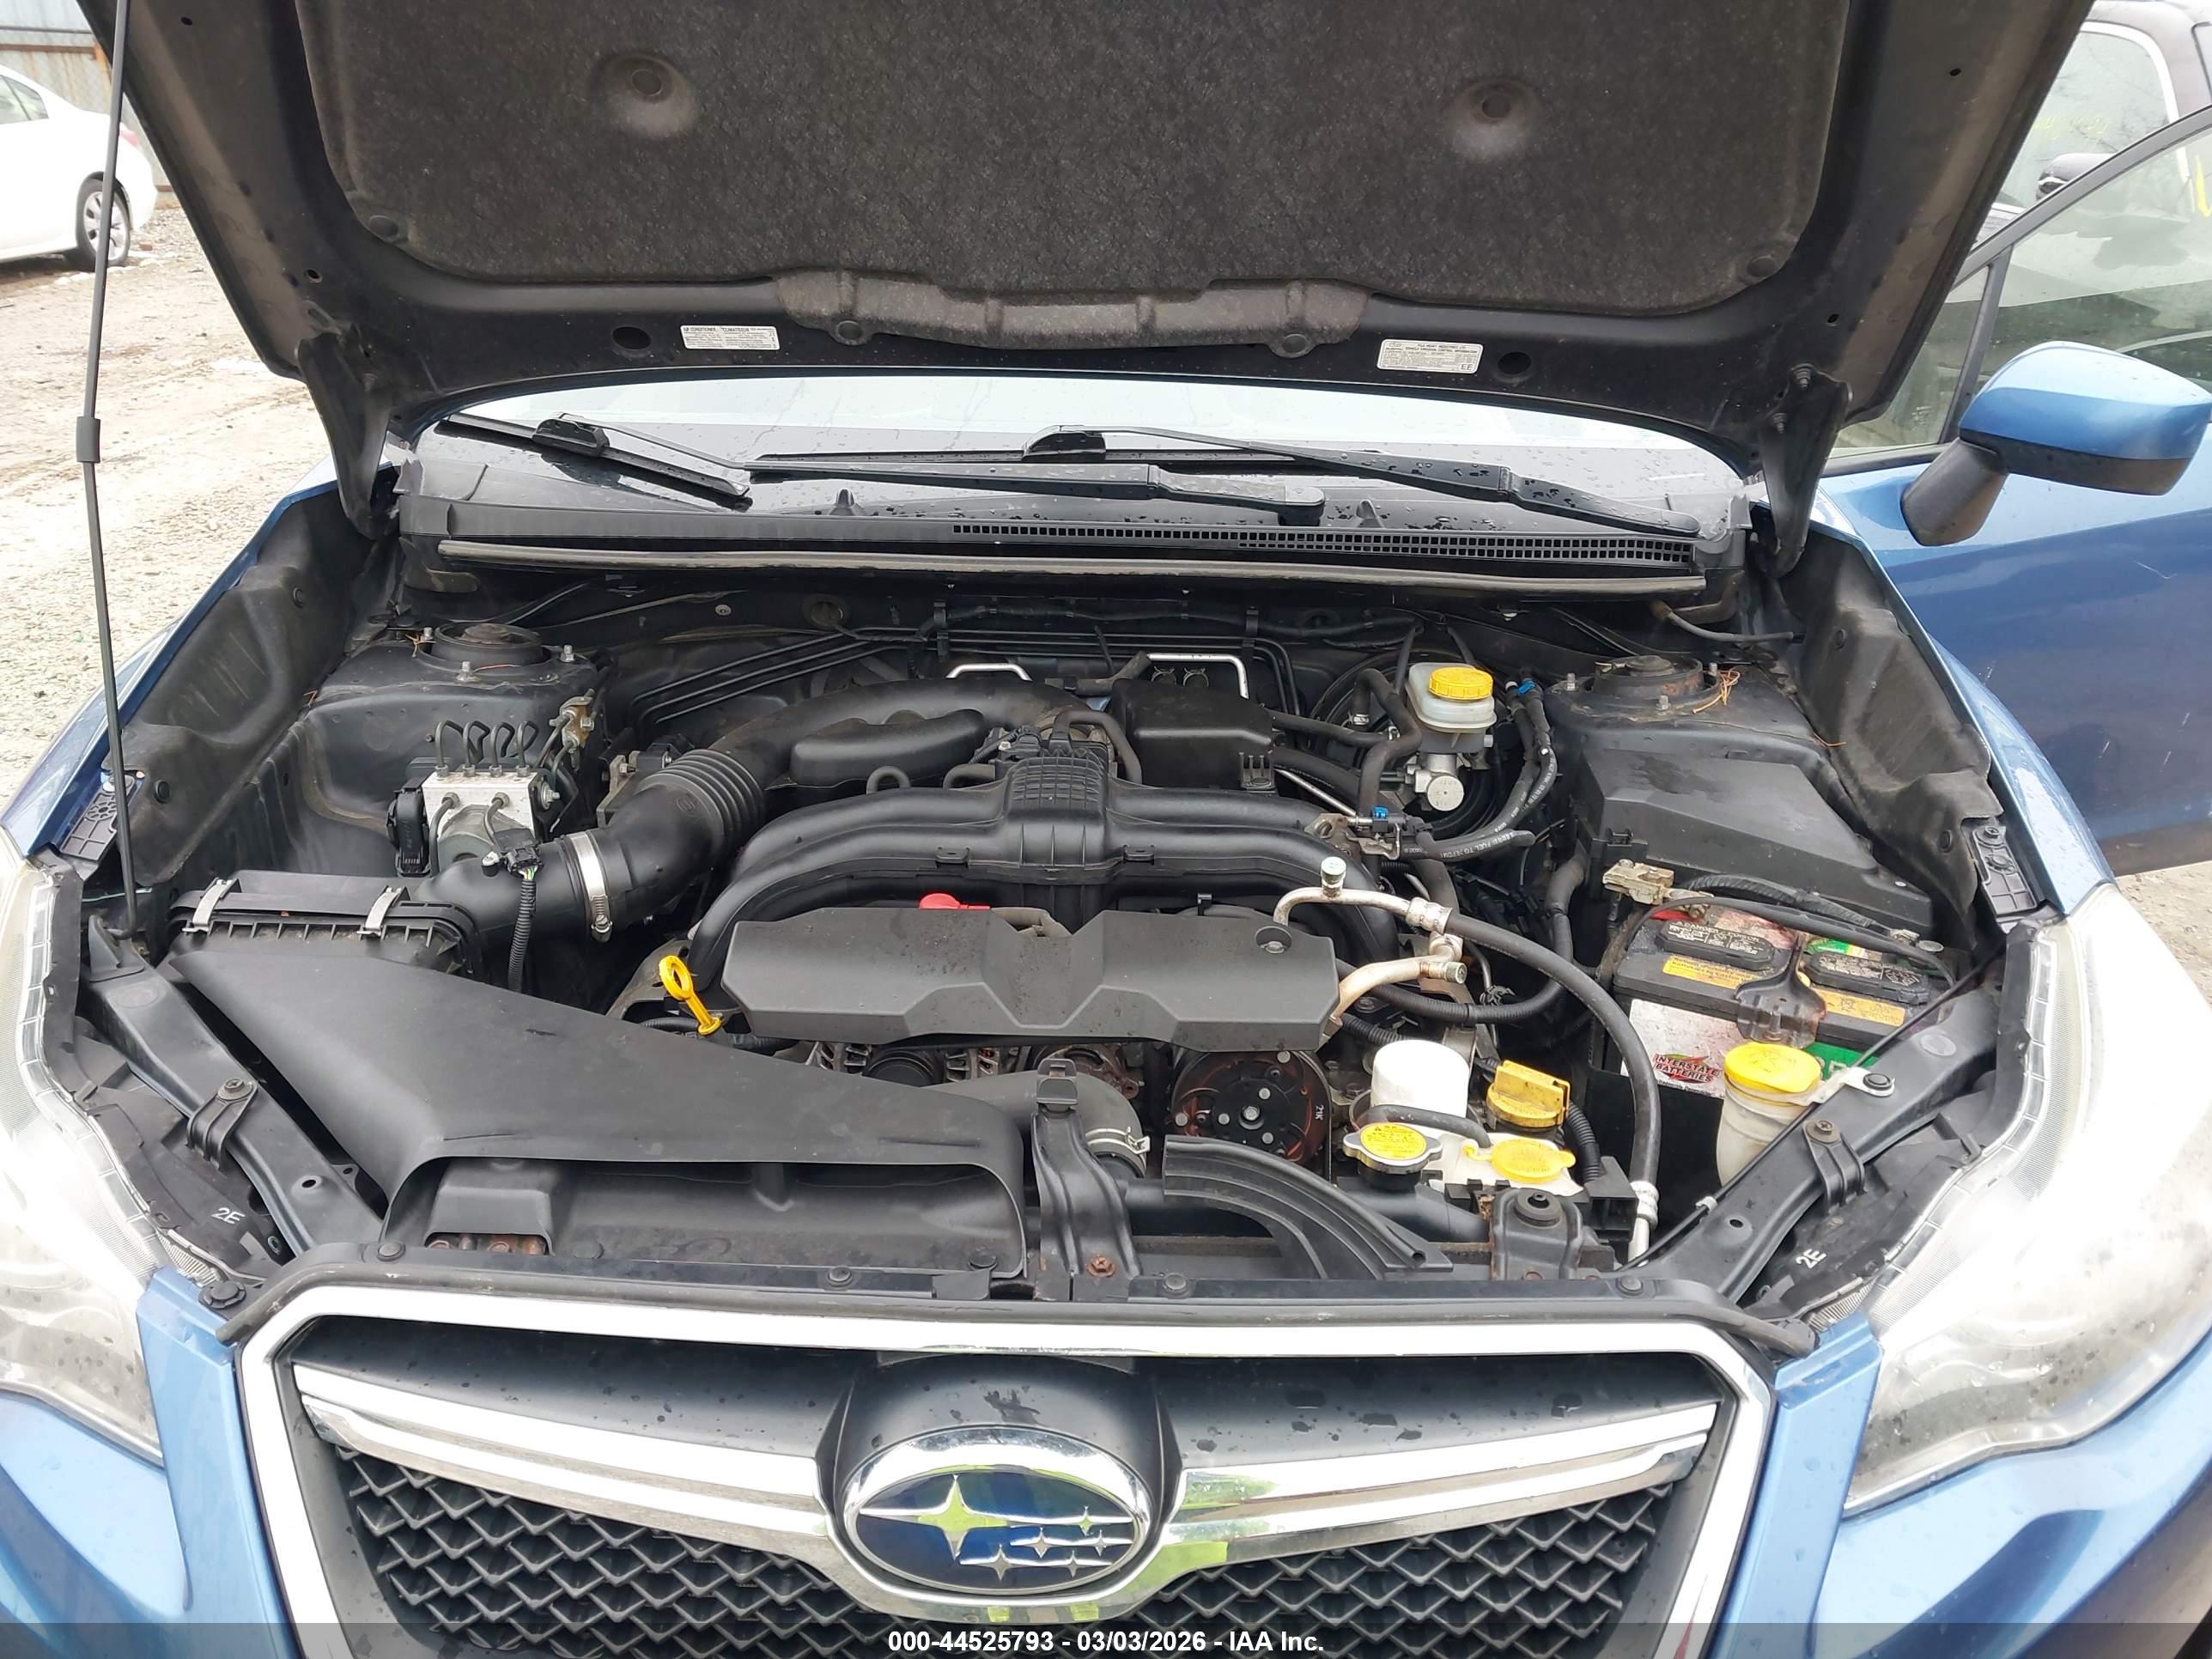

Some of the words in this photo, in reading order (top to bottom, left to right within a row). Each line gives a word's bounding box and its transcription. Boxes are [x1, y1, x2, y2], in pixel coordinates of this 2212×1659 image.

[1654, 1053, 1720, 1077] INTERSTATE
[1656, 1063, 1713, 1083] BATTERIES
[210, 1206, 247, 1224] 2E
[1796, 1249, 1826, 1268] 2E
